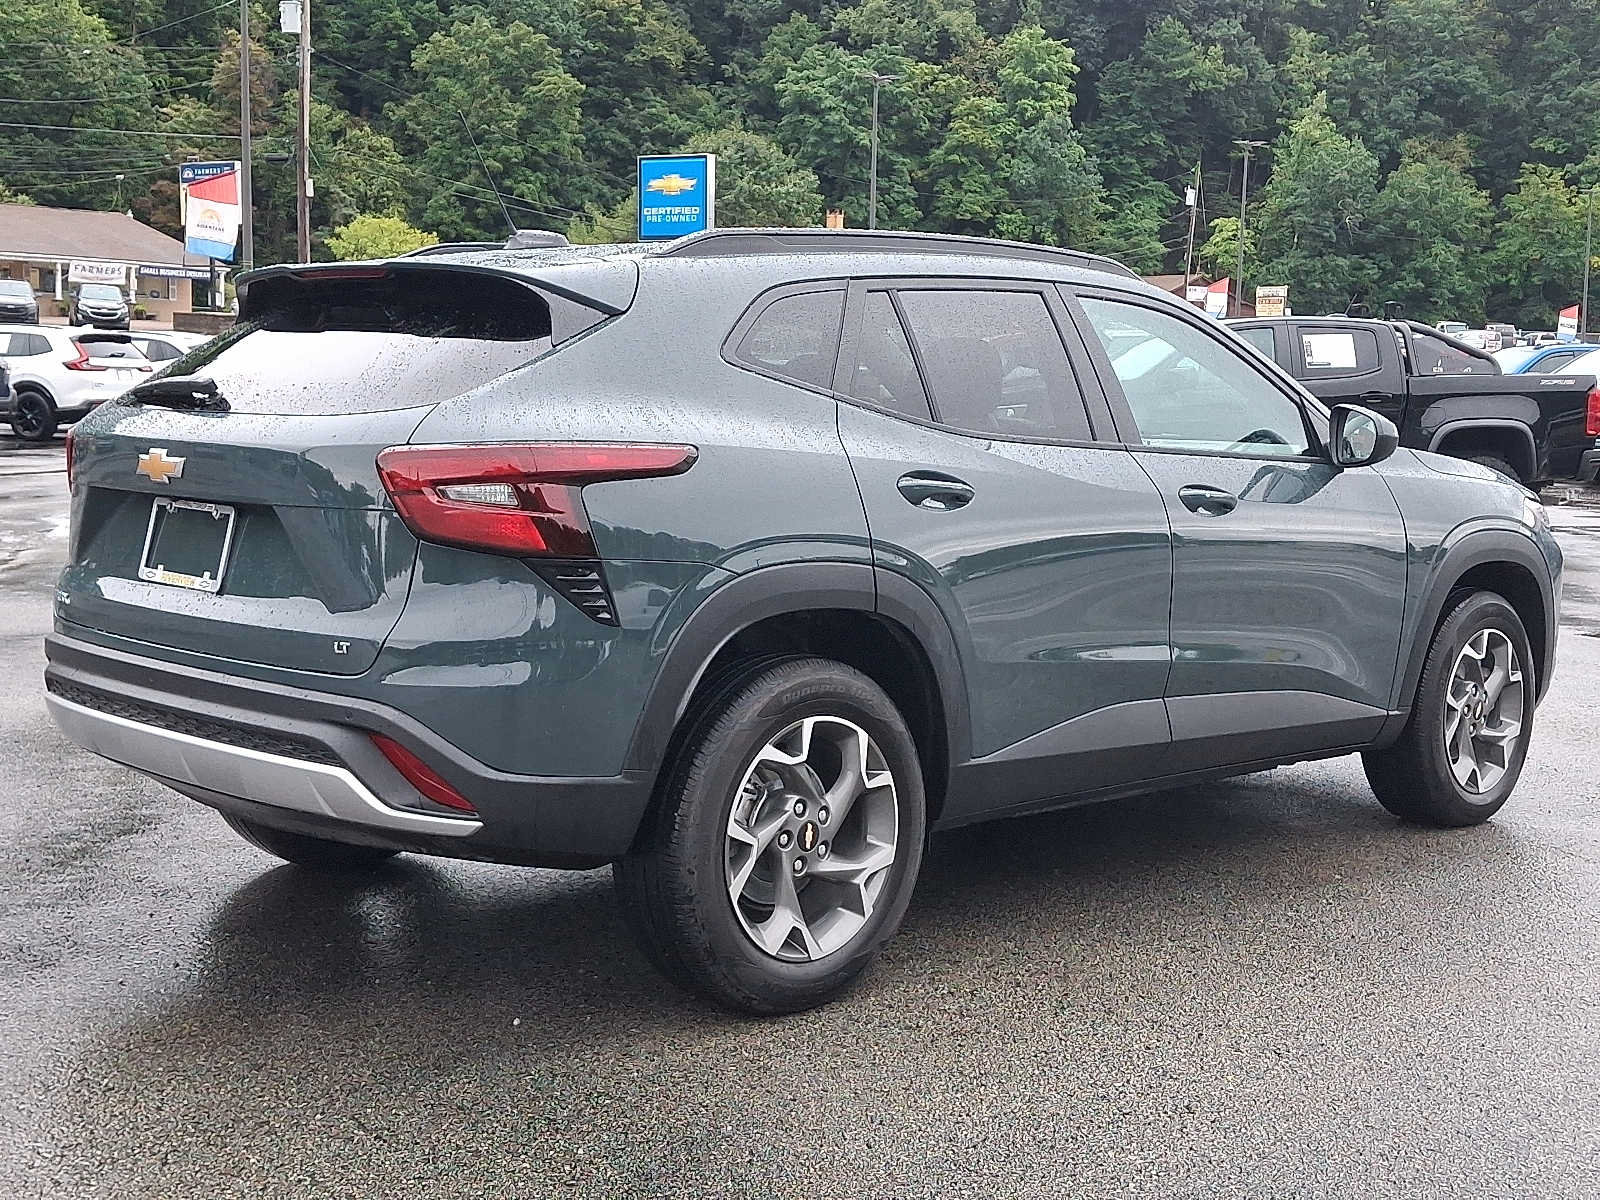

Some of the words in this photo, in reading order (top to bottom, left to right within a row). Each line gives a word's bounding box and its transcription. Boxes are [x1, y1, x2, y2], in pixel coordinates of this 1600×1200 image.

[644, 207, 699, 215] CERTIFIED
[74, 264, 122, 276] FARMERS
[140, 266, 158, 275] SMALL
[160, 268, 185, 277] BUSINESS
[187, 270, 210, 279] INSURAN
[333, 641, 351, 655] LT
